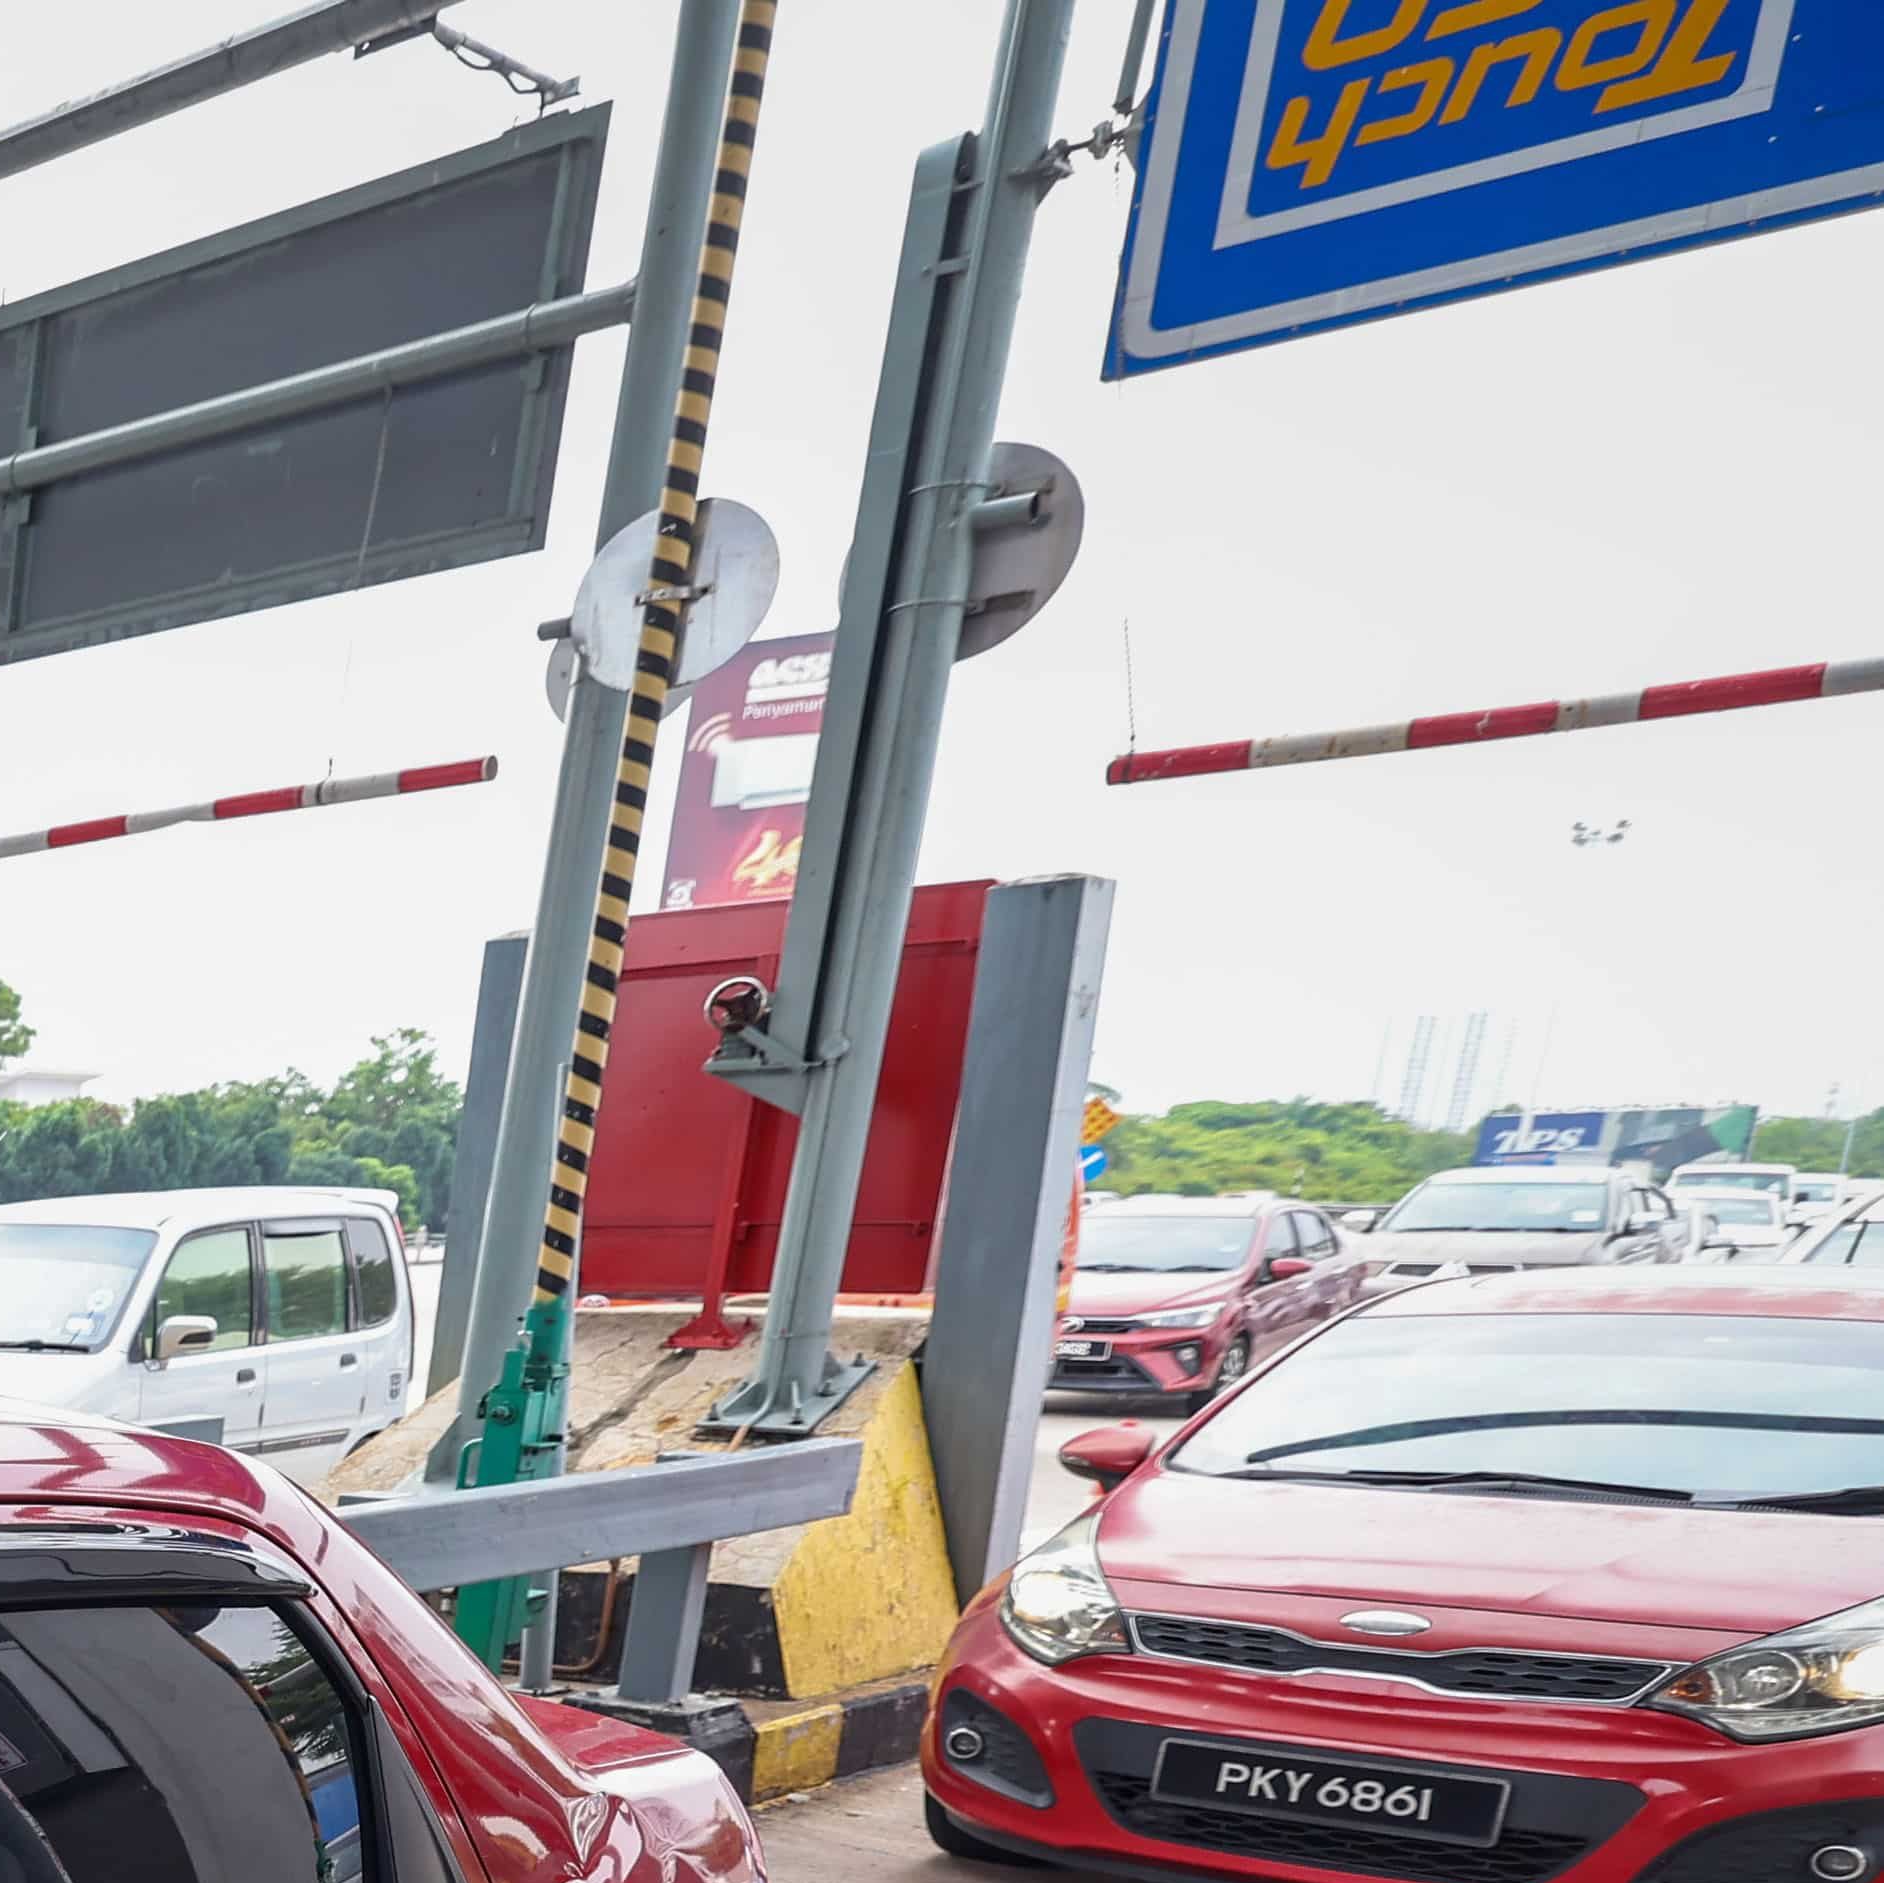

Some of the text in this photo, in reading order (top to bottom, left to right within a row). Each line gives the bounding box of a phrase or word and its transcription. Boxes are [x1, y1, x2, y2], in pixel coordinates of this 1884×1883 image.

[1265, 0, 1739, 189] Touch
[1215, 1761, 1433, 1821] PKY 6861
